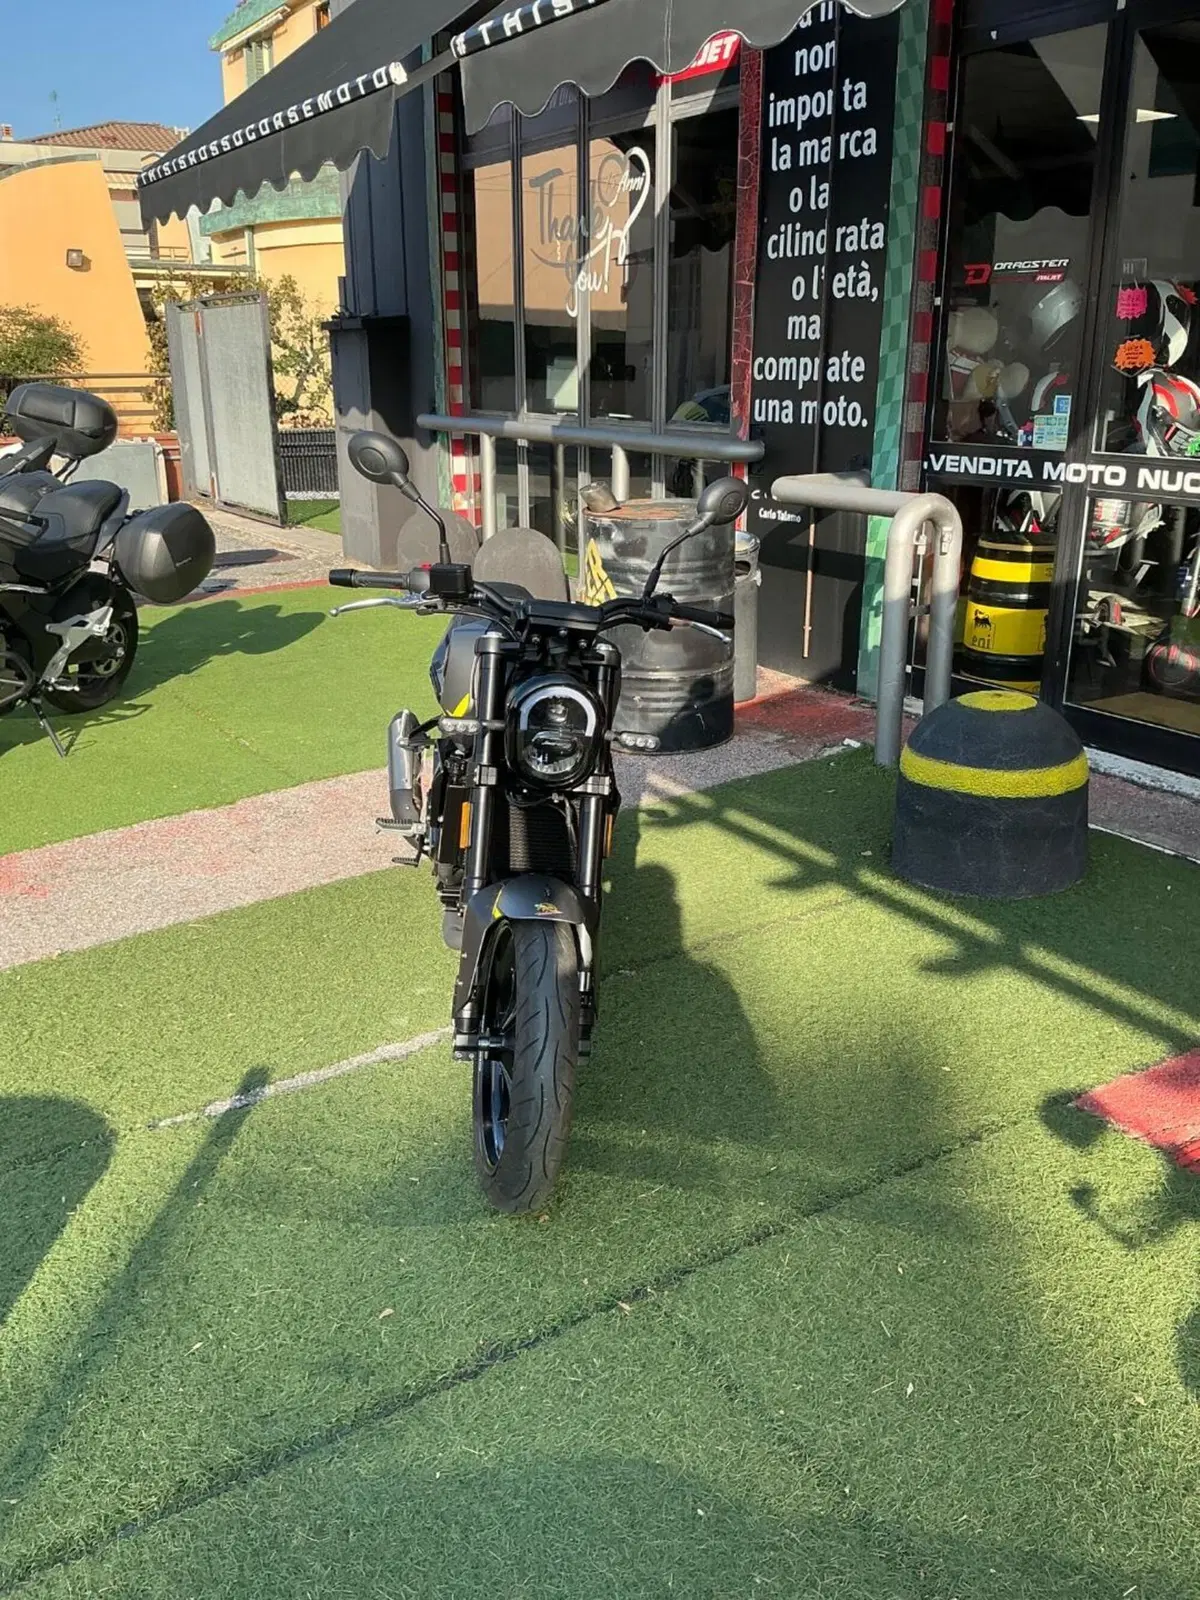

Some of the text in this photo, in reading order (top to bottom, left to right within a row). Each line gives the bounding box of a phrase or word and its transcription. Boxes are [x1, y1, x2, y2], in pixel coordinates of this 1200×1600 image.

[795, 40, 836, 76] non
[771, 127, 878, 172] la marca
[789, 175, 829, 213] o la
[993, 258, 1070, 271] DRAGSTER
[792, 275, 806, 301] o
[787, 314, 821, 340] ma
[754, 398, 794, 424] una
[929, 453, 1034, 479] VENDITA
[1042, 462, 1127, 487] MOTO
[971, 634, 991, 649] eni
